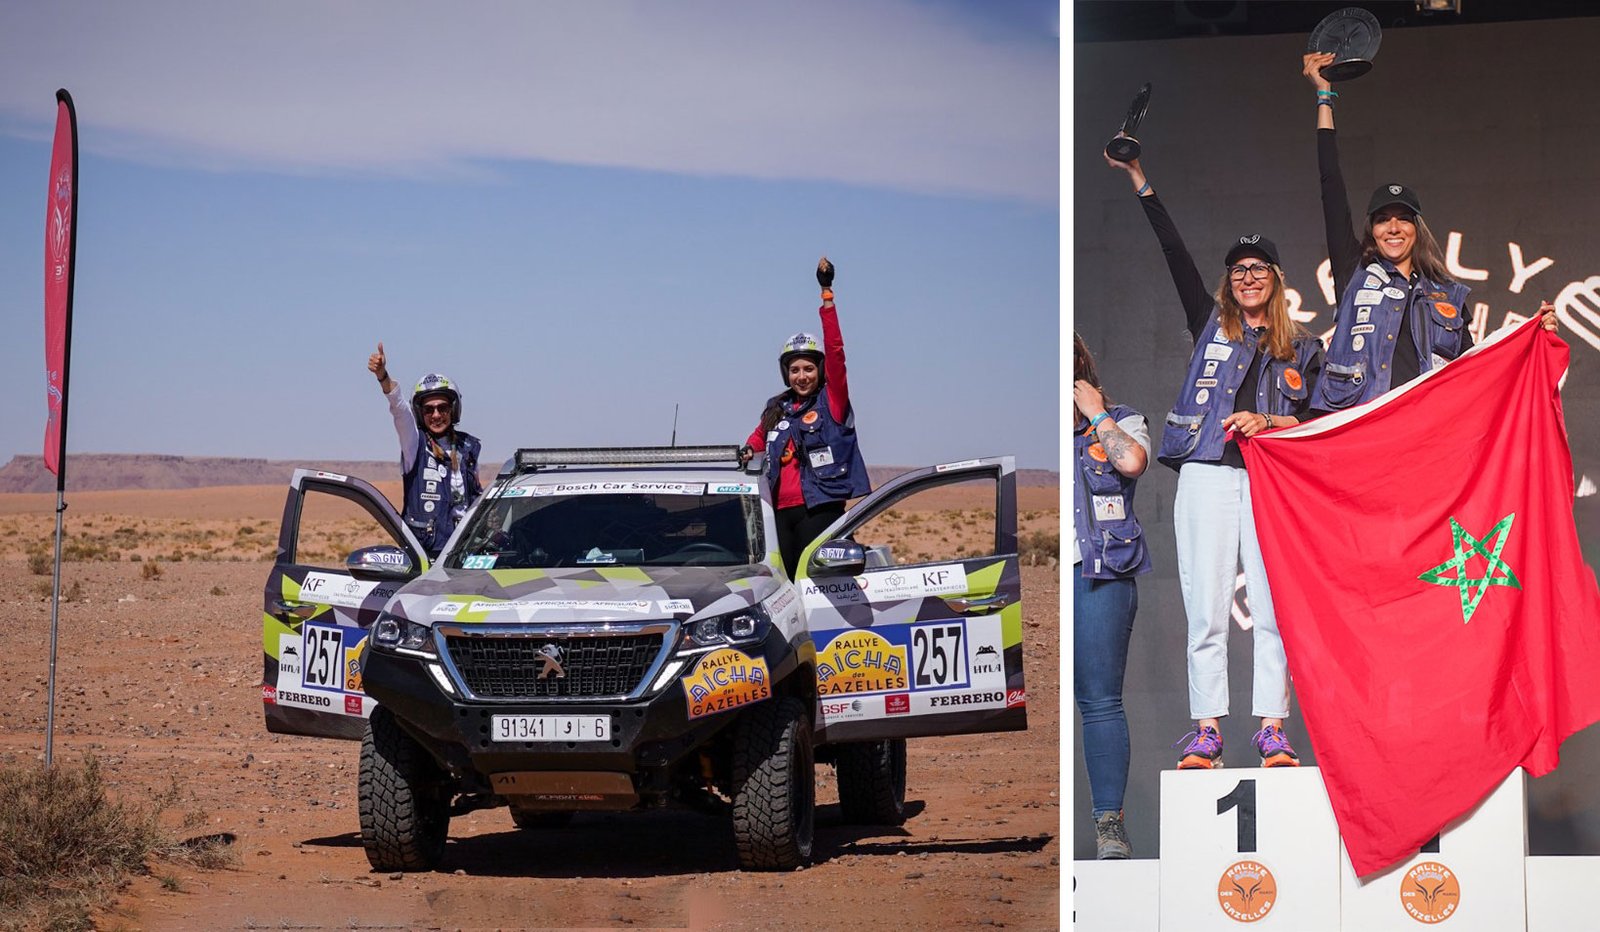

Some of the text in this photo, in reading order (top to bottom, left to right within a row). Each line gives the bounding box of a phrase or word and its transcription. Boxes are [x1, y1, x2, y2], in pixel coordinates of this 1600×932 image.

[556, 482, 683, 492] Bosch Car Service
[382, 553, 405, 565] GNV
[464, 555, 494, 569] 257
[302, 577, 326, 592] KF
[923, 570, 950, 586] KF
[805, 582, 858, 595] AFRIQUIA
[835, 638, 879, 650] RALLYE
[306, 627, 342, 686] 257
[702, 652, 741, 671] RALLYE
[914, 626, 962, 686] 257
[817, 677, 905, 696] GAZELLES
[278, 690, 331, 707] FERRERO
[692, 686, 769, 716] GAZELLES
[930, 691, 1005, 707] FERRERO
[820, 703, 850, 715] GSF
[501, 718, 544, 738] 91341
[563, 720, 572, 735] و
[595, 718, 604, 738] 6
[1216, 778, 1257, 853] 1
[1226, 863, 1268, 878] RALLYE
[1409, 863, 1451, 879] RALLYE
[1223, 900, 1271, 921] GAZELLES
[1405, 902, 1455, 922] GAZELLES
